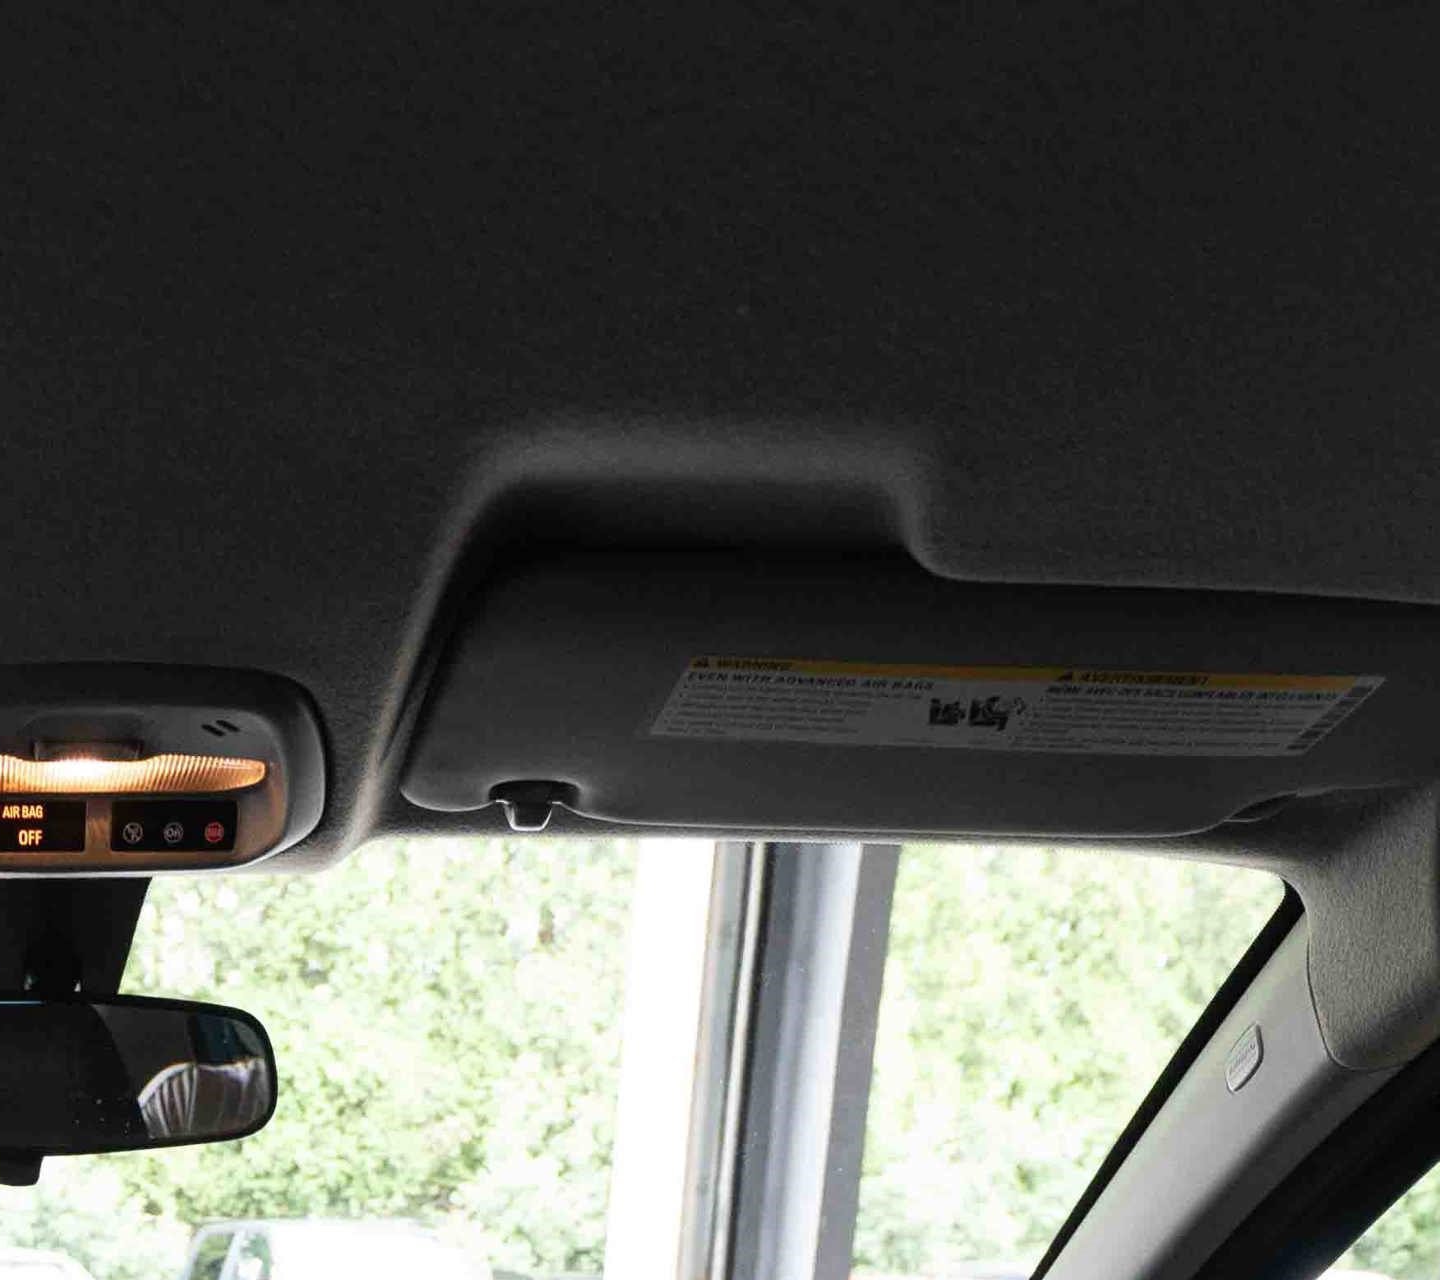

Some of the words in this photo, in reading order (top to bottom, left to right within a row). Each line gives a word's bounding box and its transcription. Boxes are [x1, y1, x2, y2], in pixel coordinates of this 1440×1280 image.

[2, 805, 20, 819] AIR
[21, 805, 44, 819] BAG
[18, 829, 43, 847] OFF
